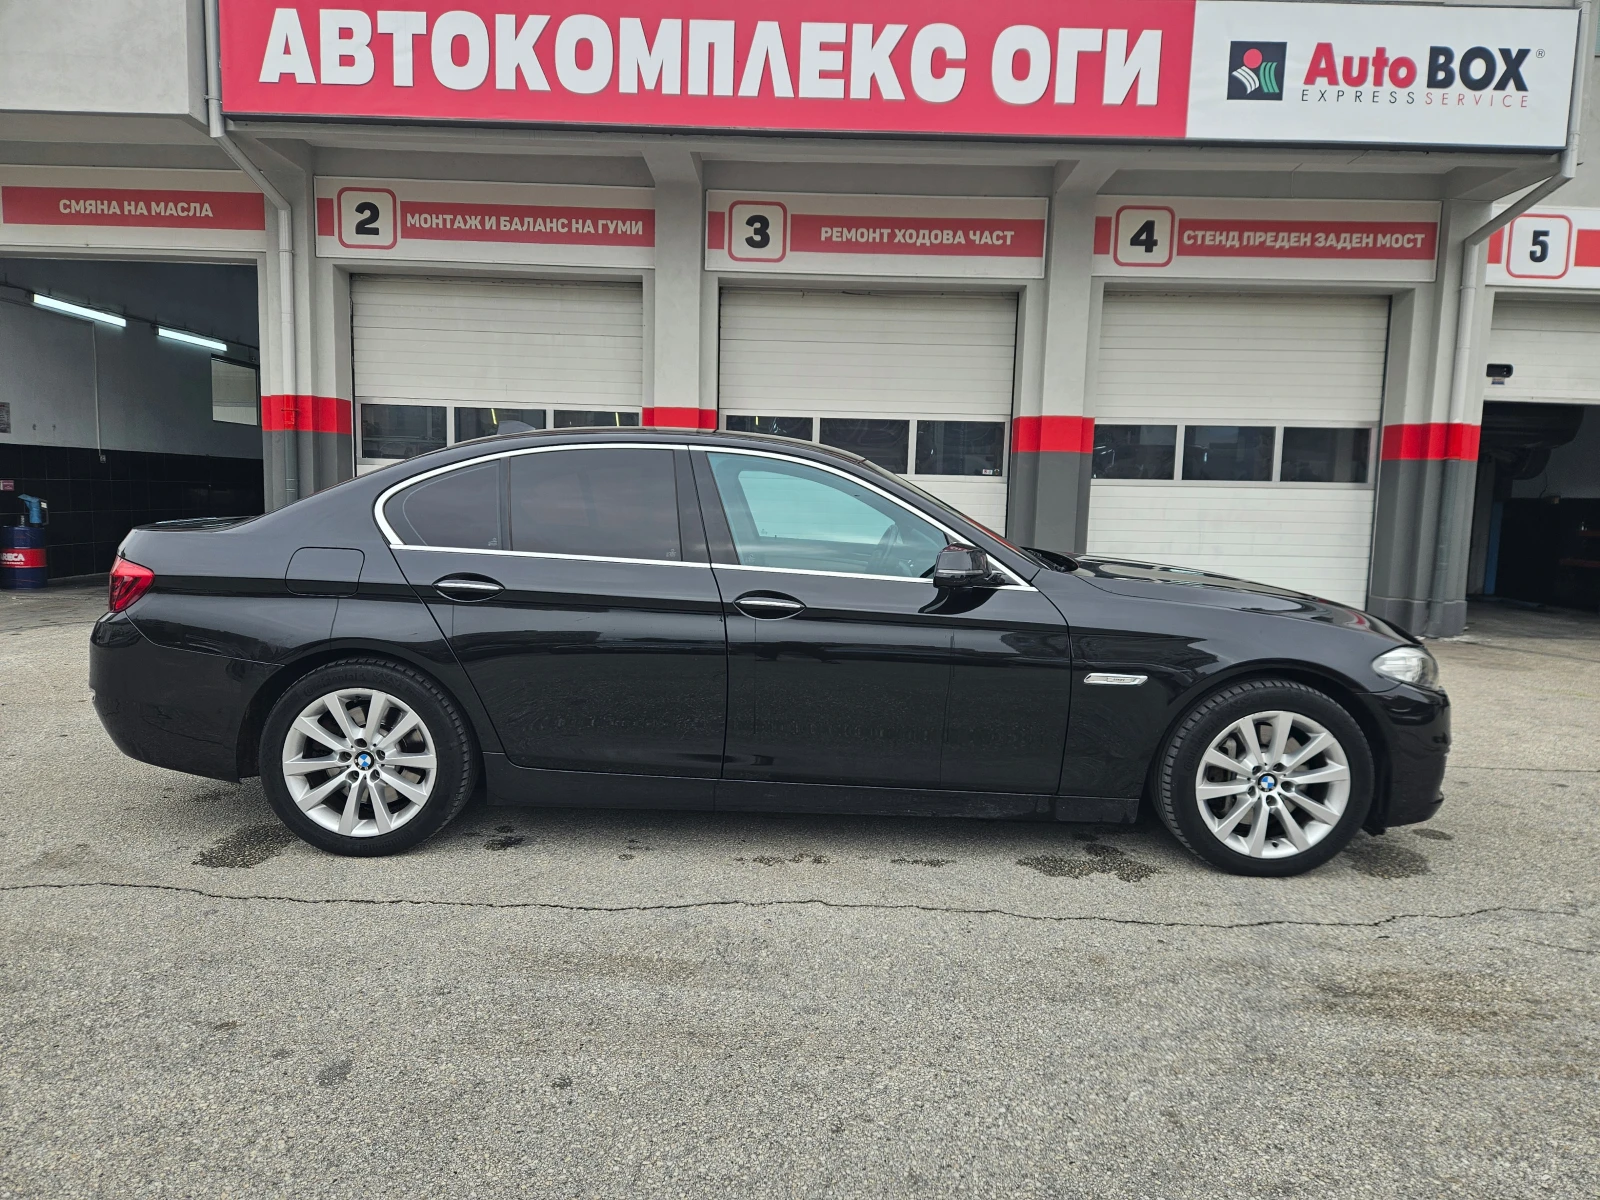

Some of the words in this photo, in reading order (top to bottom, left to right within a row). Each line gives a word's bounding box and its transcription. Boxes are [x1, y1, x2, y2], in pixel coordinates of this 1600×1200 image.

[259, 8, 967, 104] АВТОКОМПЛЕКС
[991, 24, 1163, 107] ОГИ
[1303, 42, 1417, 88] Auto
[1426, 46, 1531, 92] BOX
[1301, 89, 1415, 104] EXPRESS
[1425, 92, 1529, 108] SERVICE
[59, 199, 121, 215] СМЯНА
[124, 201, 148, 216] НА
[151, 202, 213, 217] МАСЛА
[354, 201, 380, 236] 2
[406, 213, 482, 230] МОНТАЖ
[485, 216, 497, 231] И
[500, 217, 569, 233] БАЛАНС
[571, 219, 595, 234] НА
[598, 219, 643, 236] ГУМИ
[744, 214, 771, 249] 3
[821, 226, 892, 243] РЕМОНТ
[893, 228, 966, 246] ХОДОВА
[969, 230, 1014, 245] ЧАСТ
[1129, 219, 1158, 253] 4
[1183, 229, 1240, 247] СТЕНД
[1242, 231, 1312, 249] ПРЕДЕН
[1314, 233, 1374, 250] ЗАДЕН
[1377, 233, 1426, 249] МОСТ
[1529, 230, 1550, 263] 5
